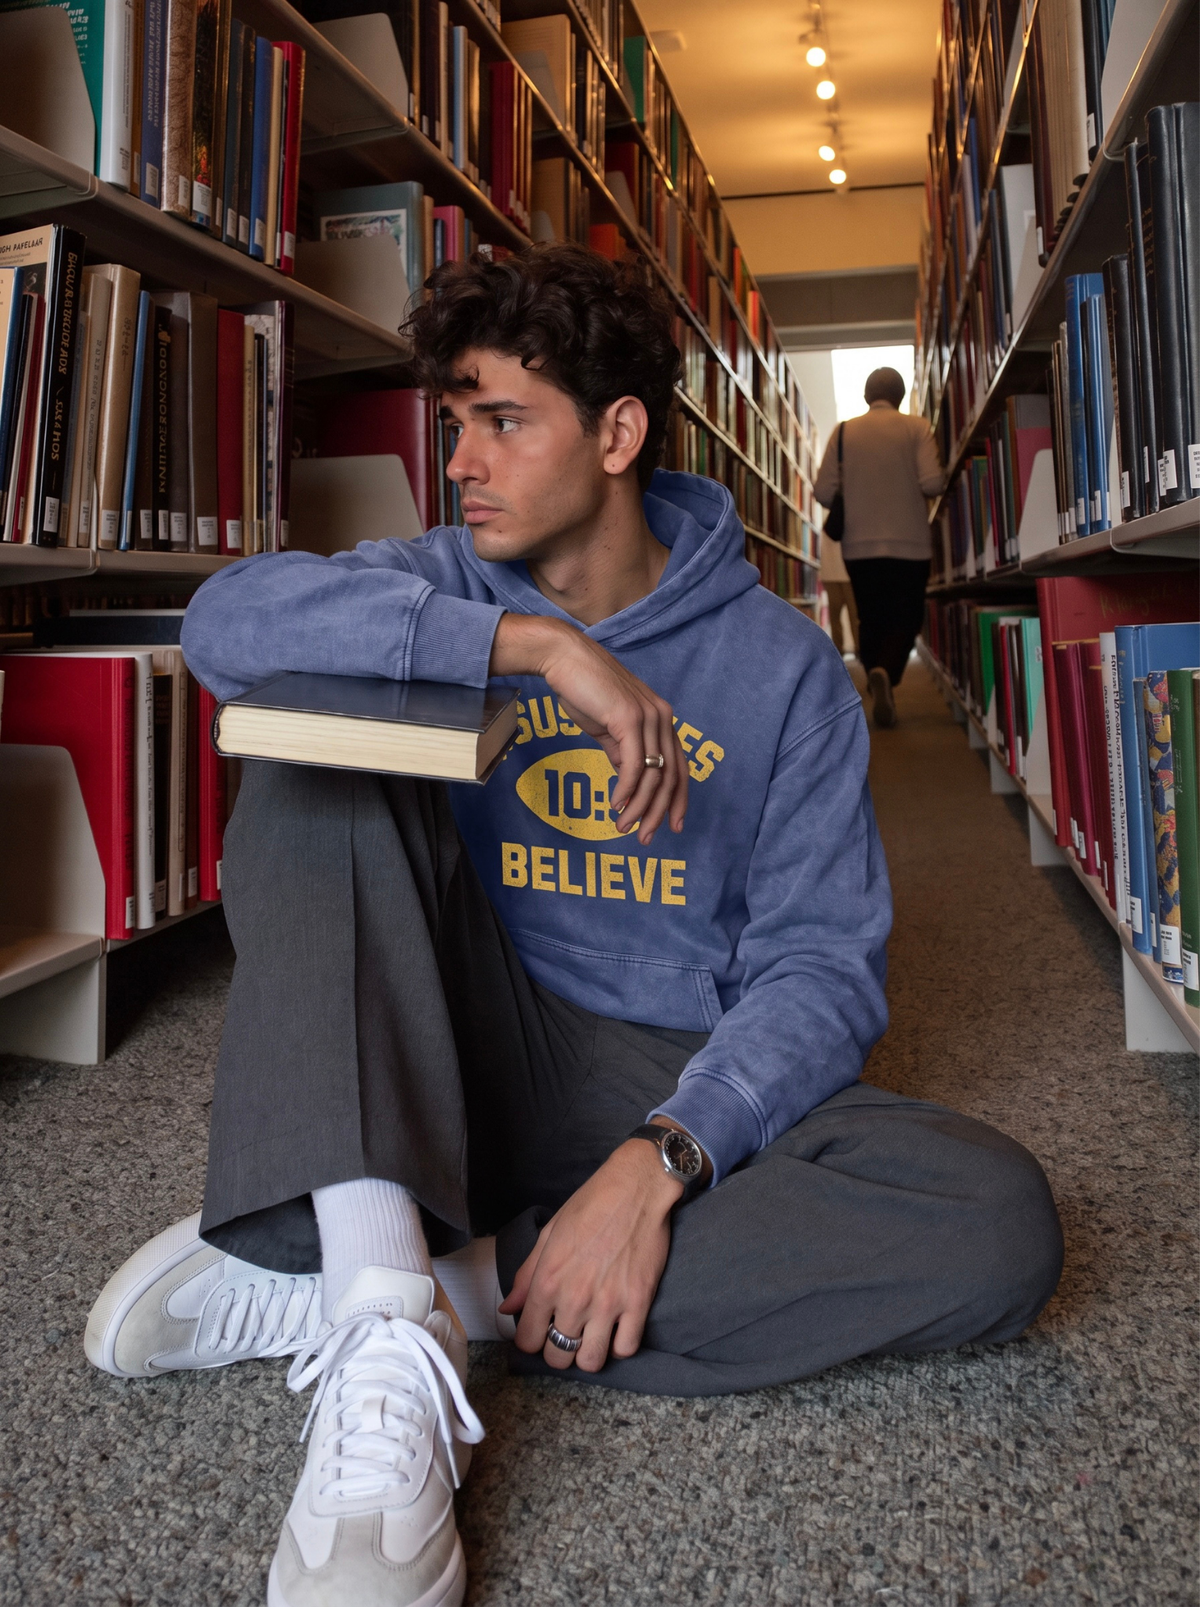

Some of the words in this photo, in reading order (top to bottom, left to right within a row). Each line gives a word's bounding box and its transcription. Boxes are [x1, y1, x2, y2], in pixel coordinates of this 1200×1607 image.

[503, 695, 583, 758] SUS
[672, 716, 725, 782] ES
[501, 842, 687, 906] BELIEVE
